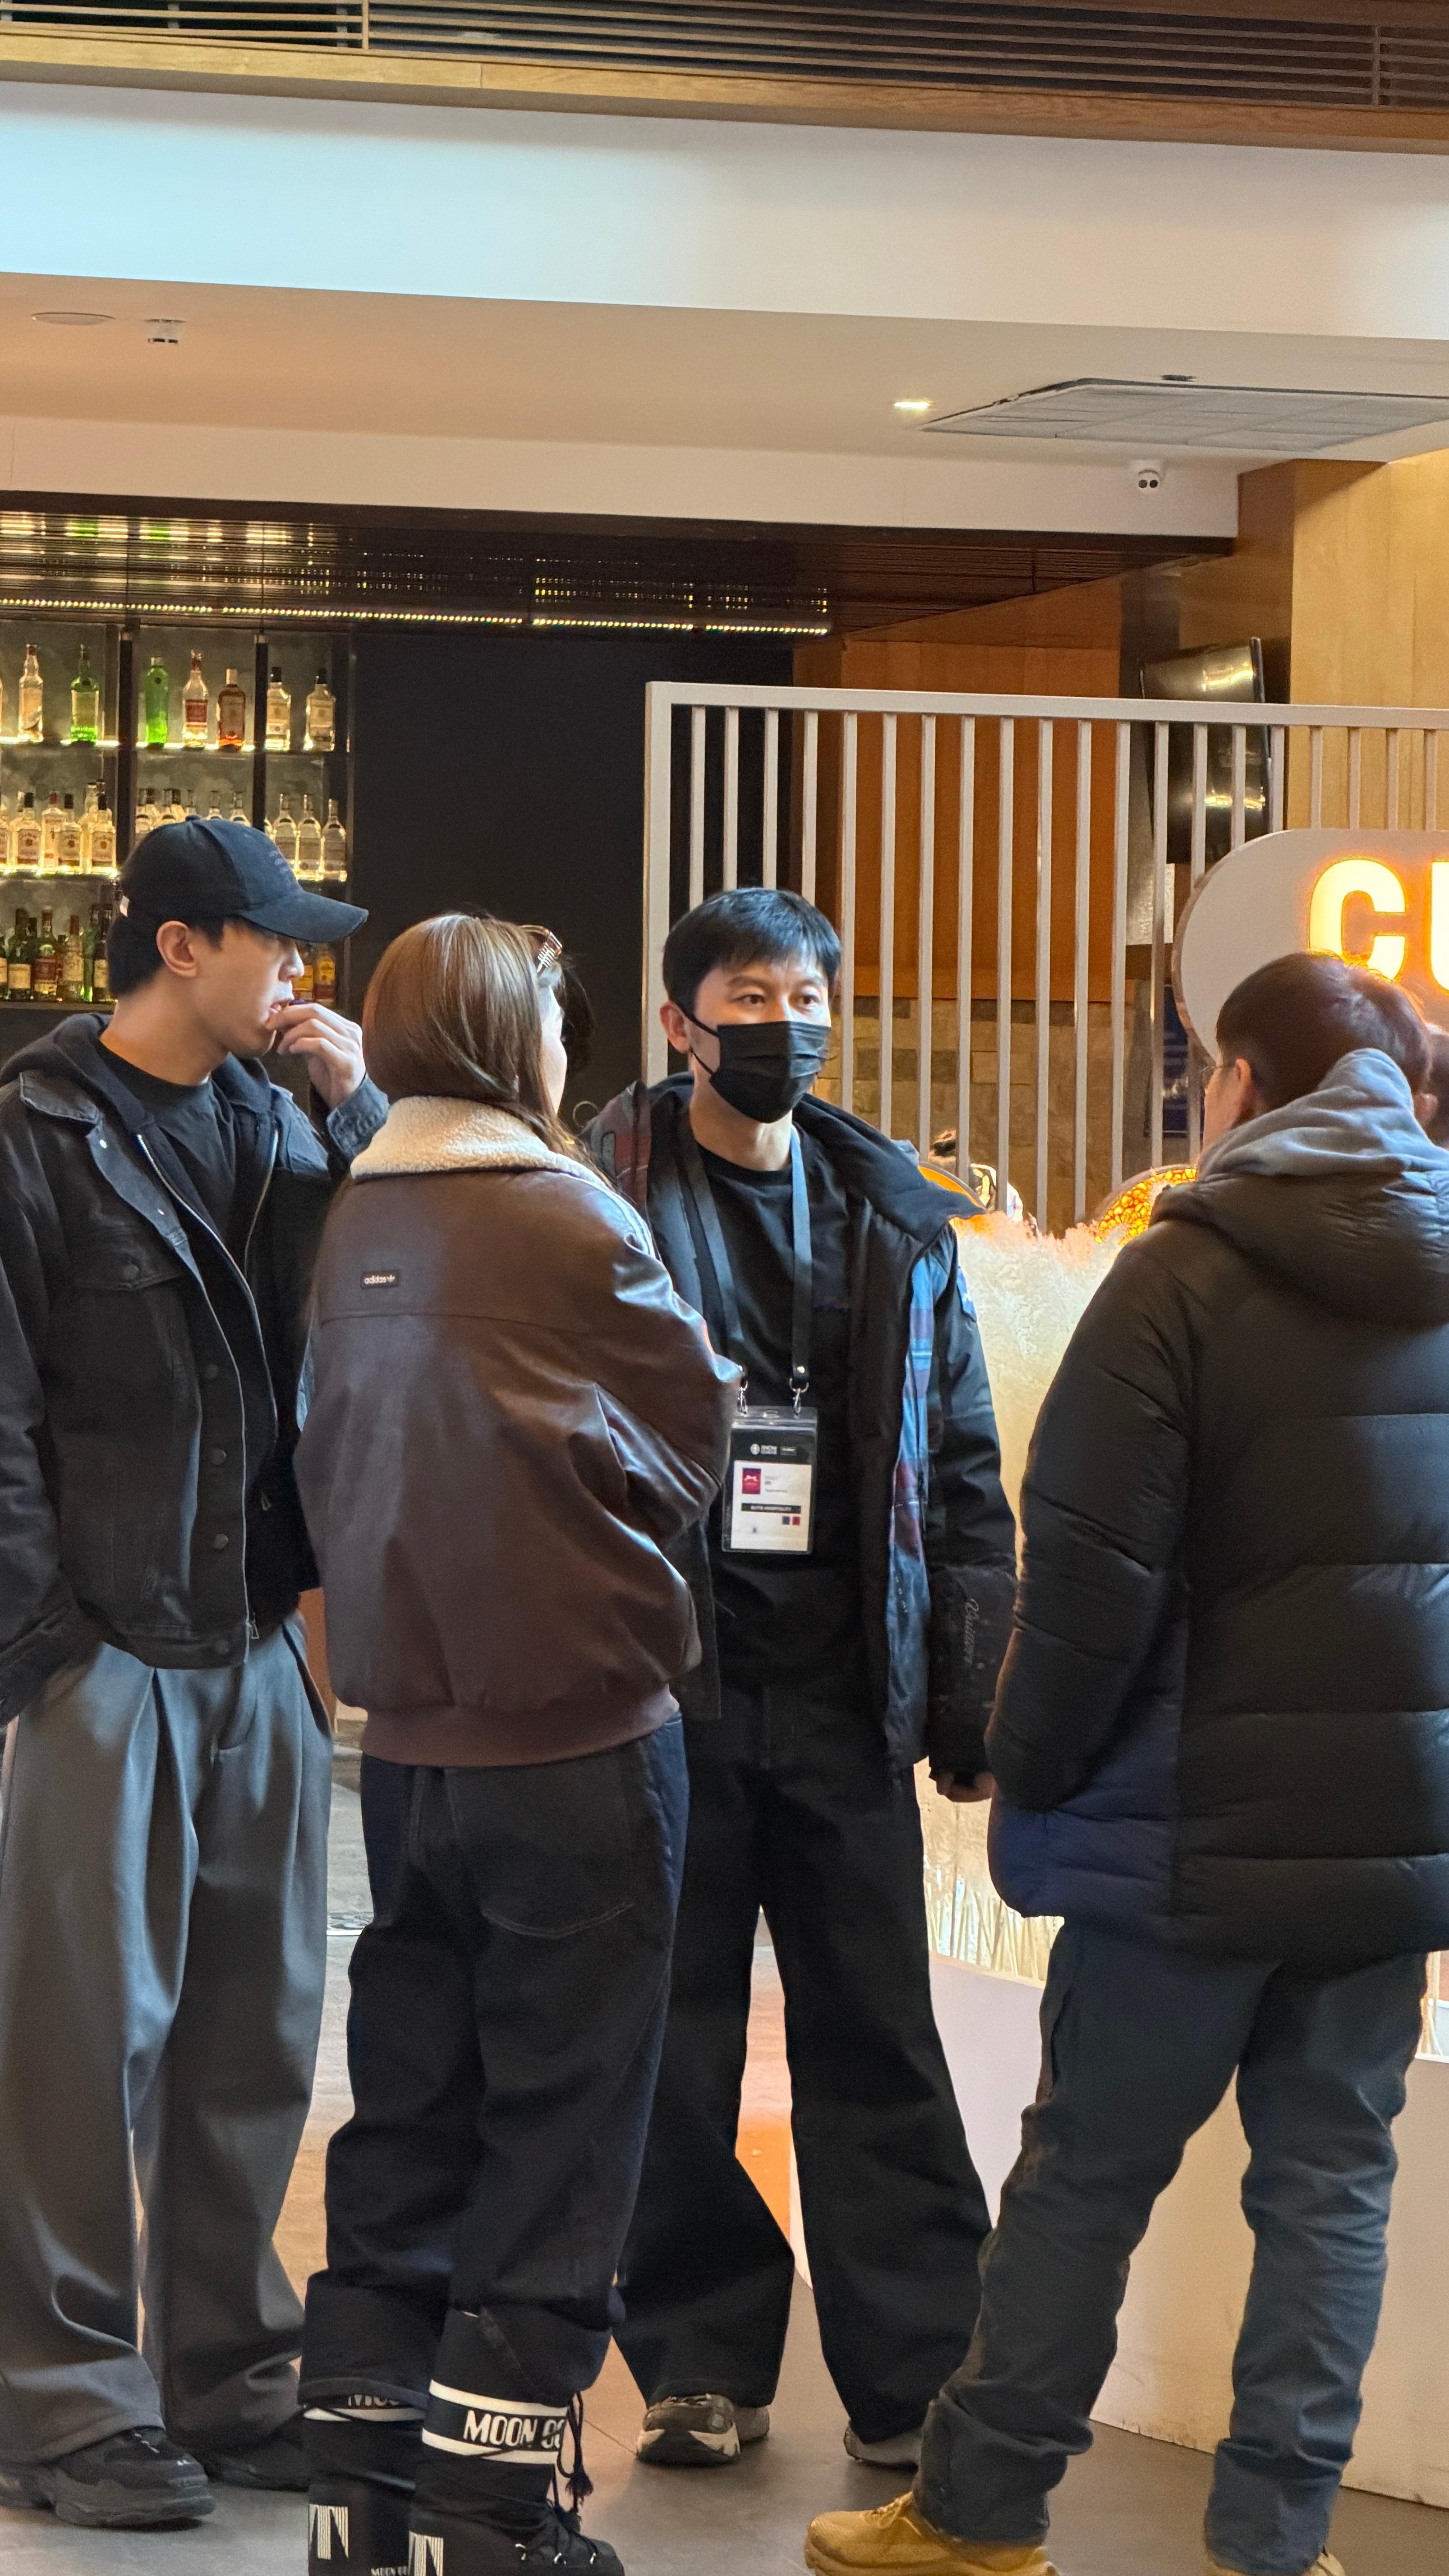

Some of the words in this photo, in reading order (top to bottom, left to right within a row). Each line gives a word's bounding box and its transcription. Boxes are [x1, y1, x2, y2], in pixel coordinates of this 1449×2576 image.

[1309, 859, 1449, 991] C
[364, 1274, 386, 1285] adidas
[464, 2410, 538, 2447] MOON
